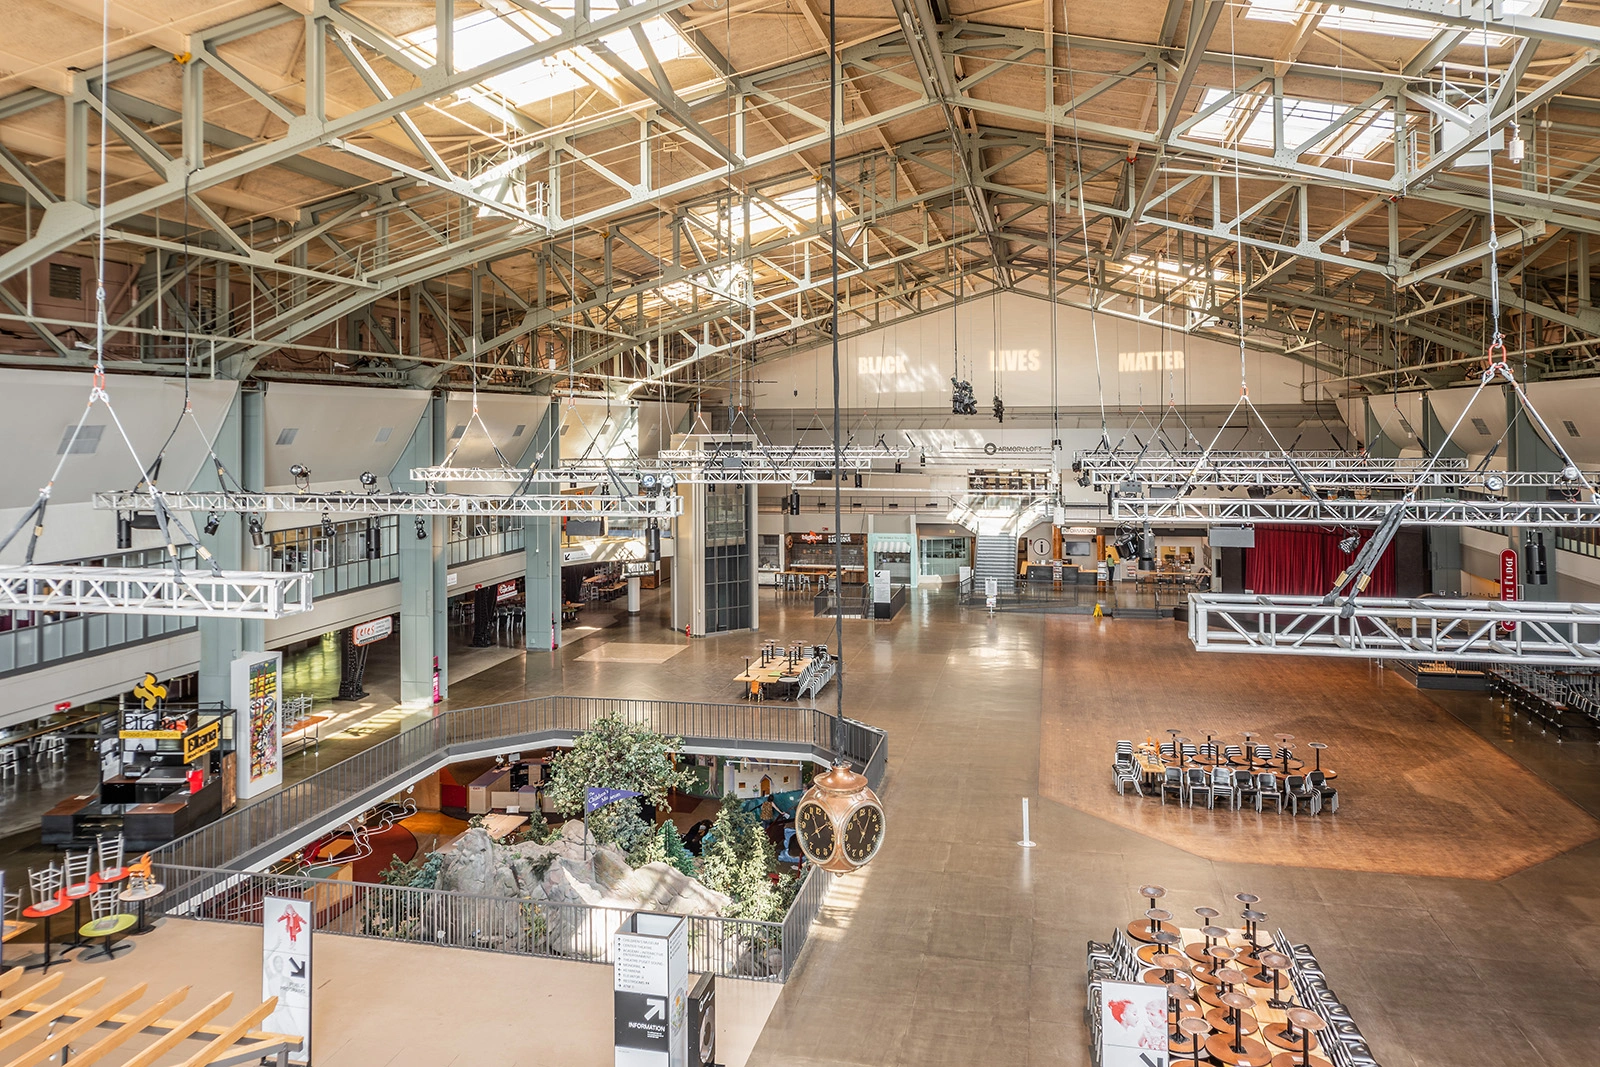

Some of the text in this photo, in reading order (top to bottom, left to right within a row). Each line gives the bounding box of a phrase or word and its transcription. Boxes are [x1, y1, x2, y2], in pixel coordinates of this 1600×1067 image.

[858, 349, 1184, 374] BLACK LIVES MATTER
[1504, 556, 1514, 585] FUDGE
[628, 1022, 665, 1032] INFORMATION
